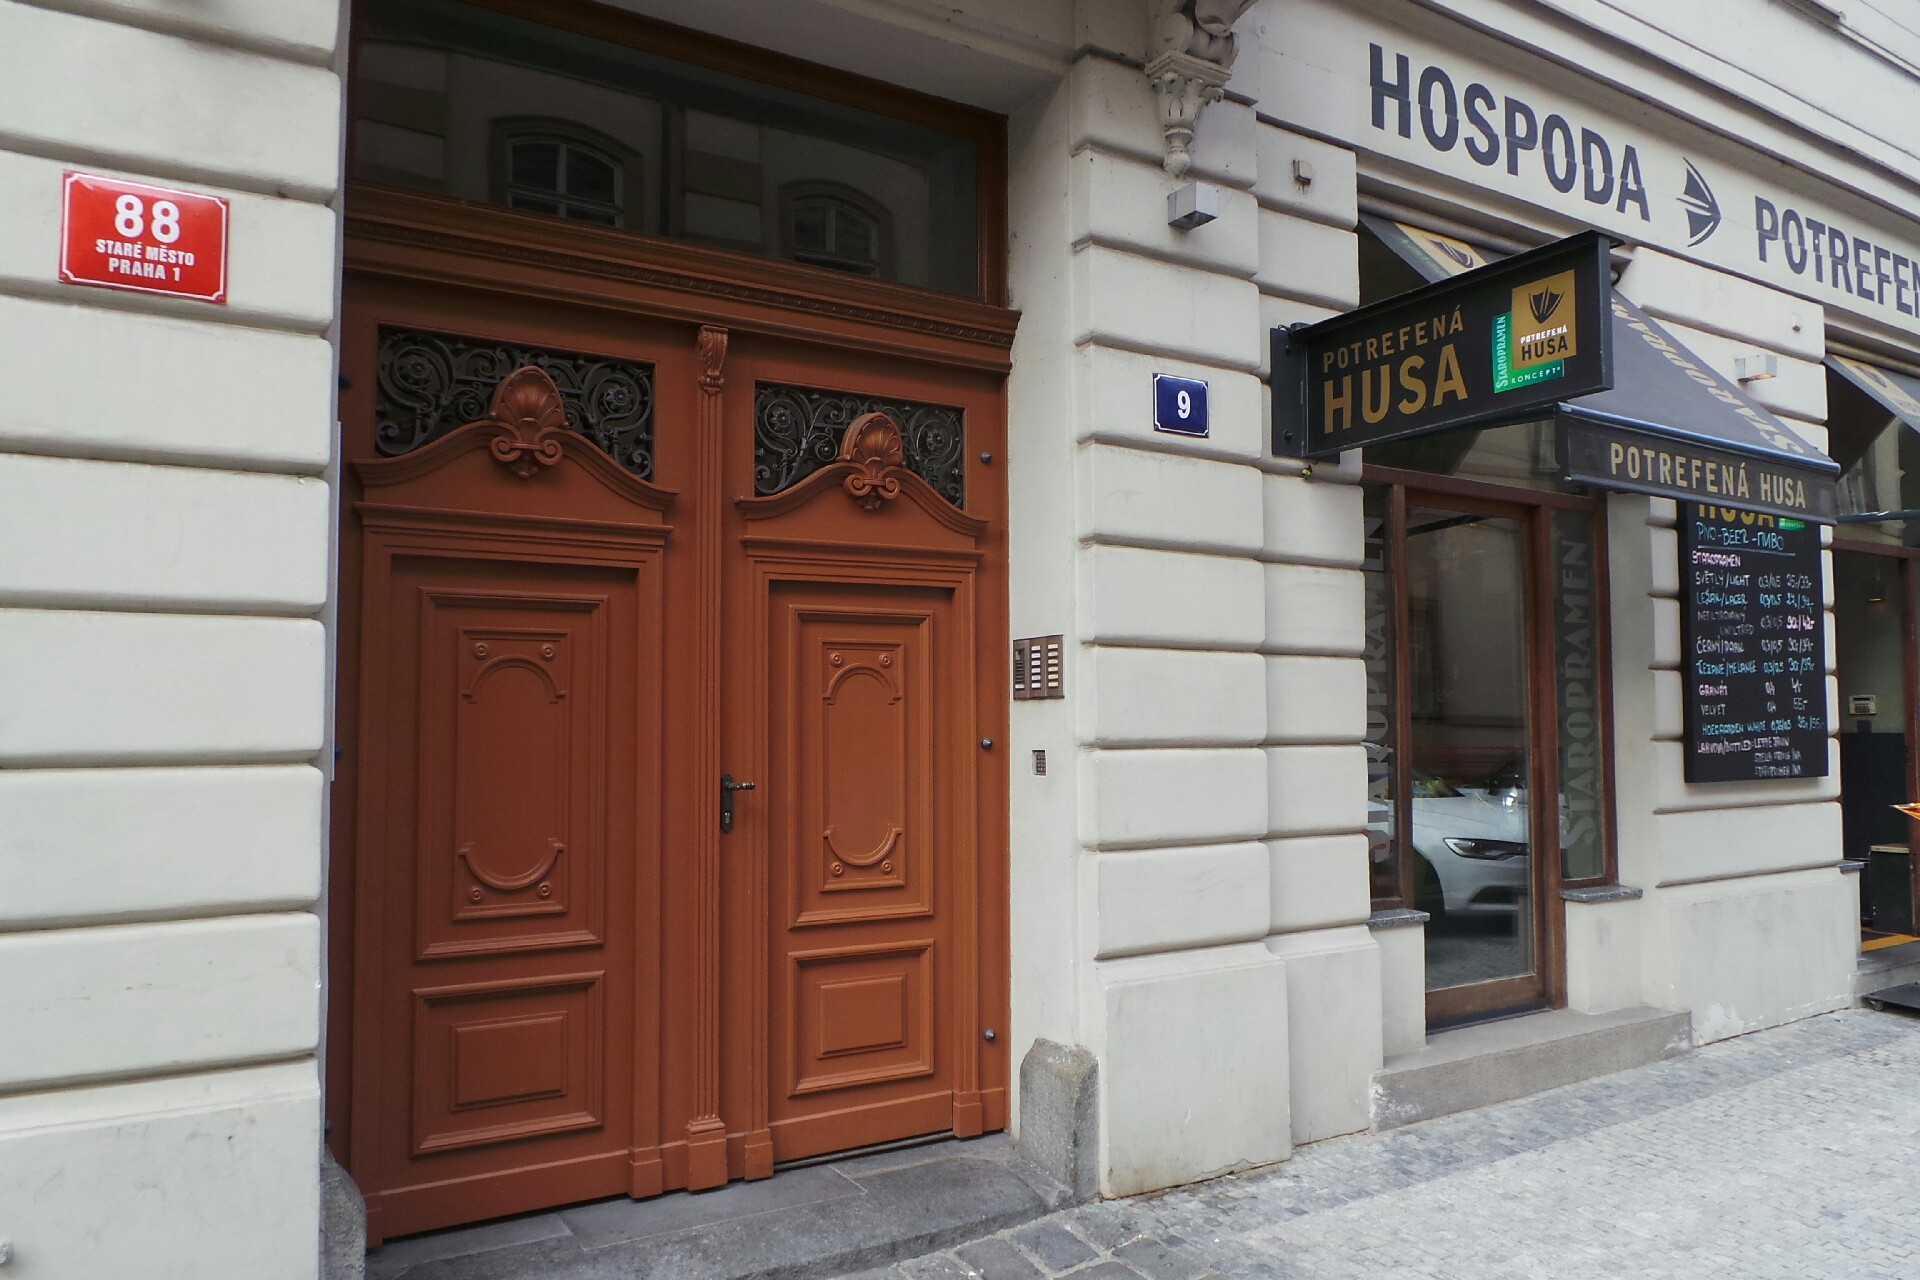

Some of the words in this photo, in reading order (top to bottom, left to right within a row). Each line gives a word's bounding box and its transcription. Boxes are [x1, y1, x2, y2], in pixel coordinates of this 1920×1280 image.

[1369, 42, 1651, 222] HOSPODA
[114, 194, 180, 244] 88
[95, 238, 143, 259] STARÉ
[145, 244, 195, 267] MĚSTO
[108, 257, 166, 279] PRAHA
[172, 267, 181, 282] 1
[1323, 304, 1464, 374] POTREFENÁ
[1496, 315, 1508, 389] STAROPRAMEN
[1520, 323, 1568, 344] POTREFENÁ
[1521, 336, 1568, 361] HUSA
[1177, 390, 1191, 419] 9
[1324, 343, 1468, 434] HUSA
[1610, 442, 1750, 499] POTREFENÁ
[1759, 472, 1806, 509] HUSA
[1560, 541, 1596, 850] STAROPRAMEN
